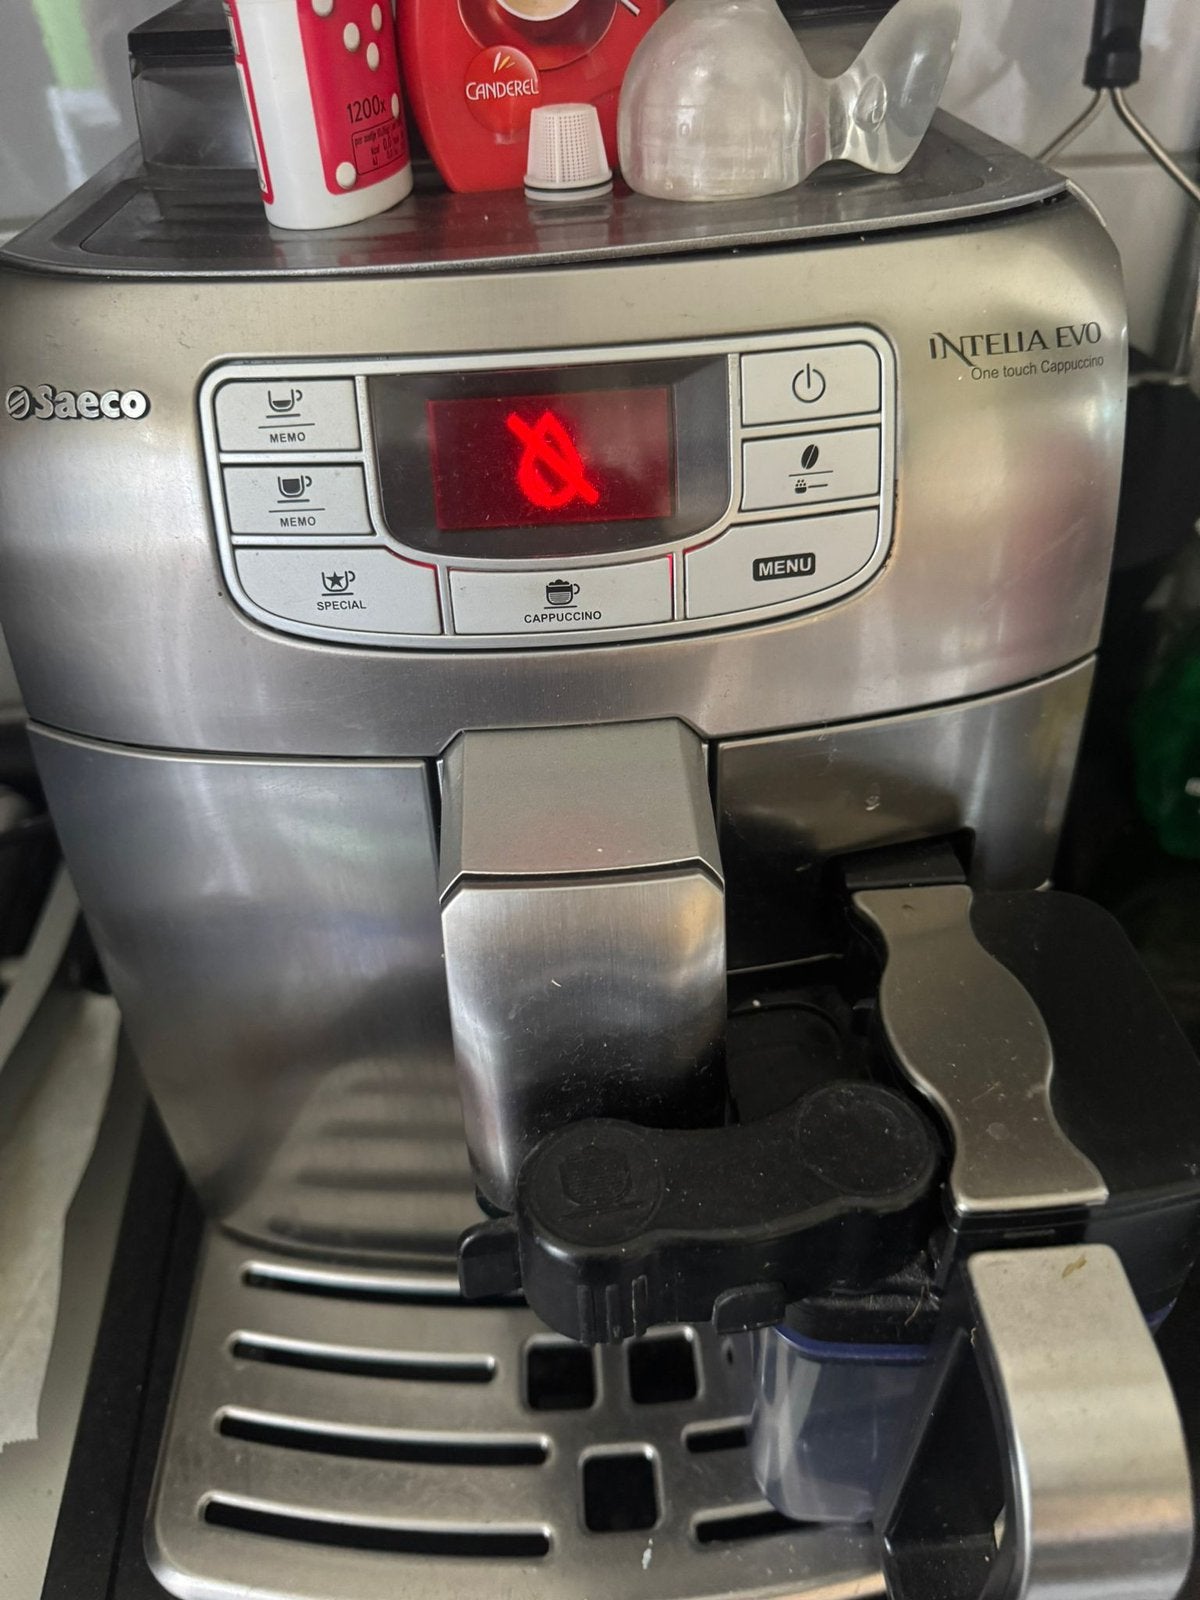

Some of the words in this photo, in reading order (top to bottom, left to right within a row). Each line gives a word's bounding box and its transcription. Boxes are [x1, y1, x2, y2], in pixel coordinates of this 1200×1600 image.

[465, 78, 540, 100] CANDEREL
[346, 94, 386, 124] 1200x
[929, 329, 1050, 367] INTELIA
[1055, 321, 1102, 348] EVO
[970, 366, 999, 381] One
[1003, 361, 1037, 378] touch
[1040, 354, 1104, 375] Cappuccino
[34, 383, 151, 420] Saeco
[269, 431, 306, 443] MEMO
[280, 516, 317, 528] MEMO
[758, 556, 812, 577] MENU
[316, 599, 367, 611] SPECIAL
[523, 610, 602, 624] CAPPUCCINO
